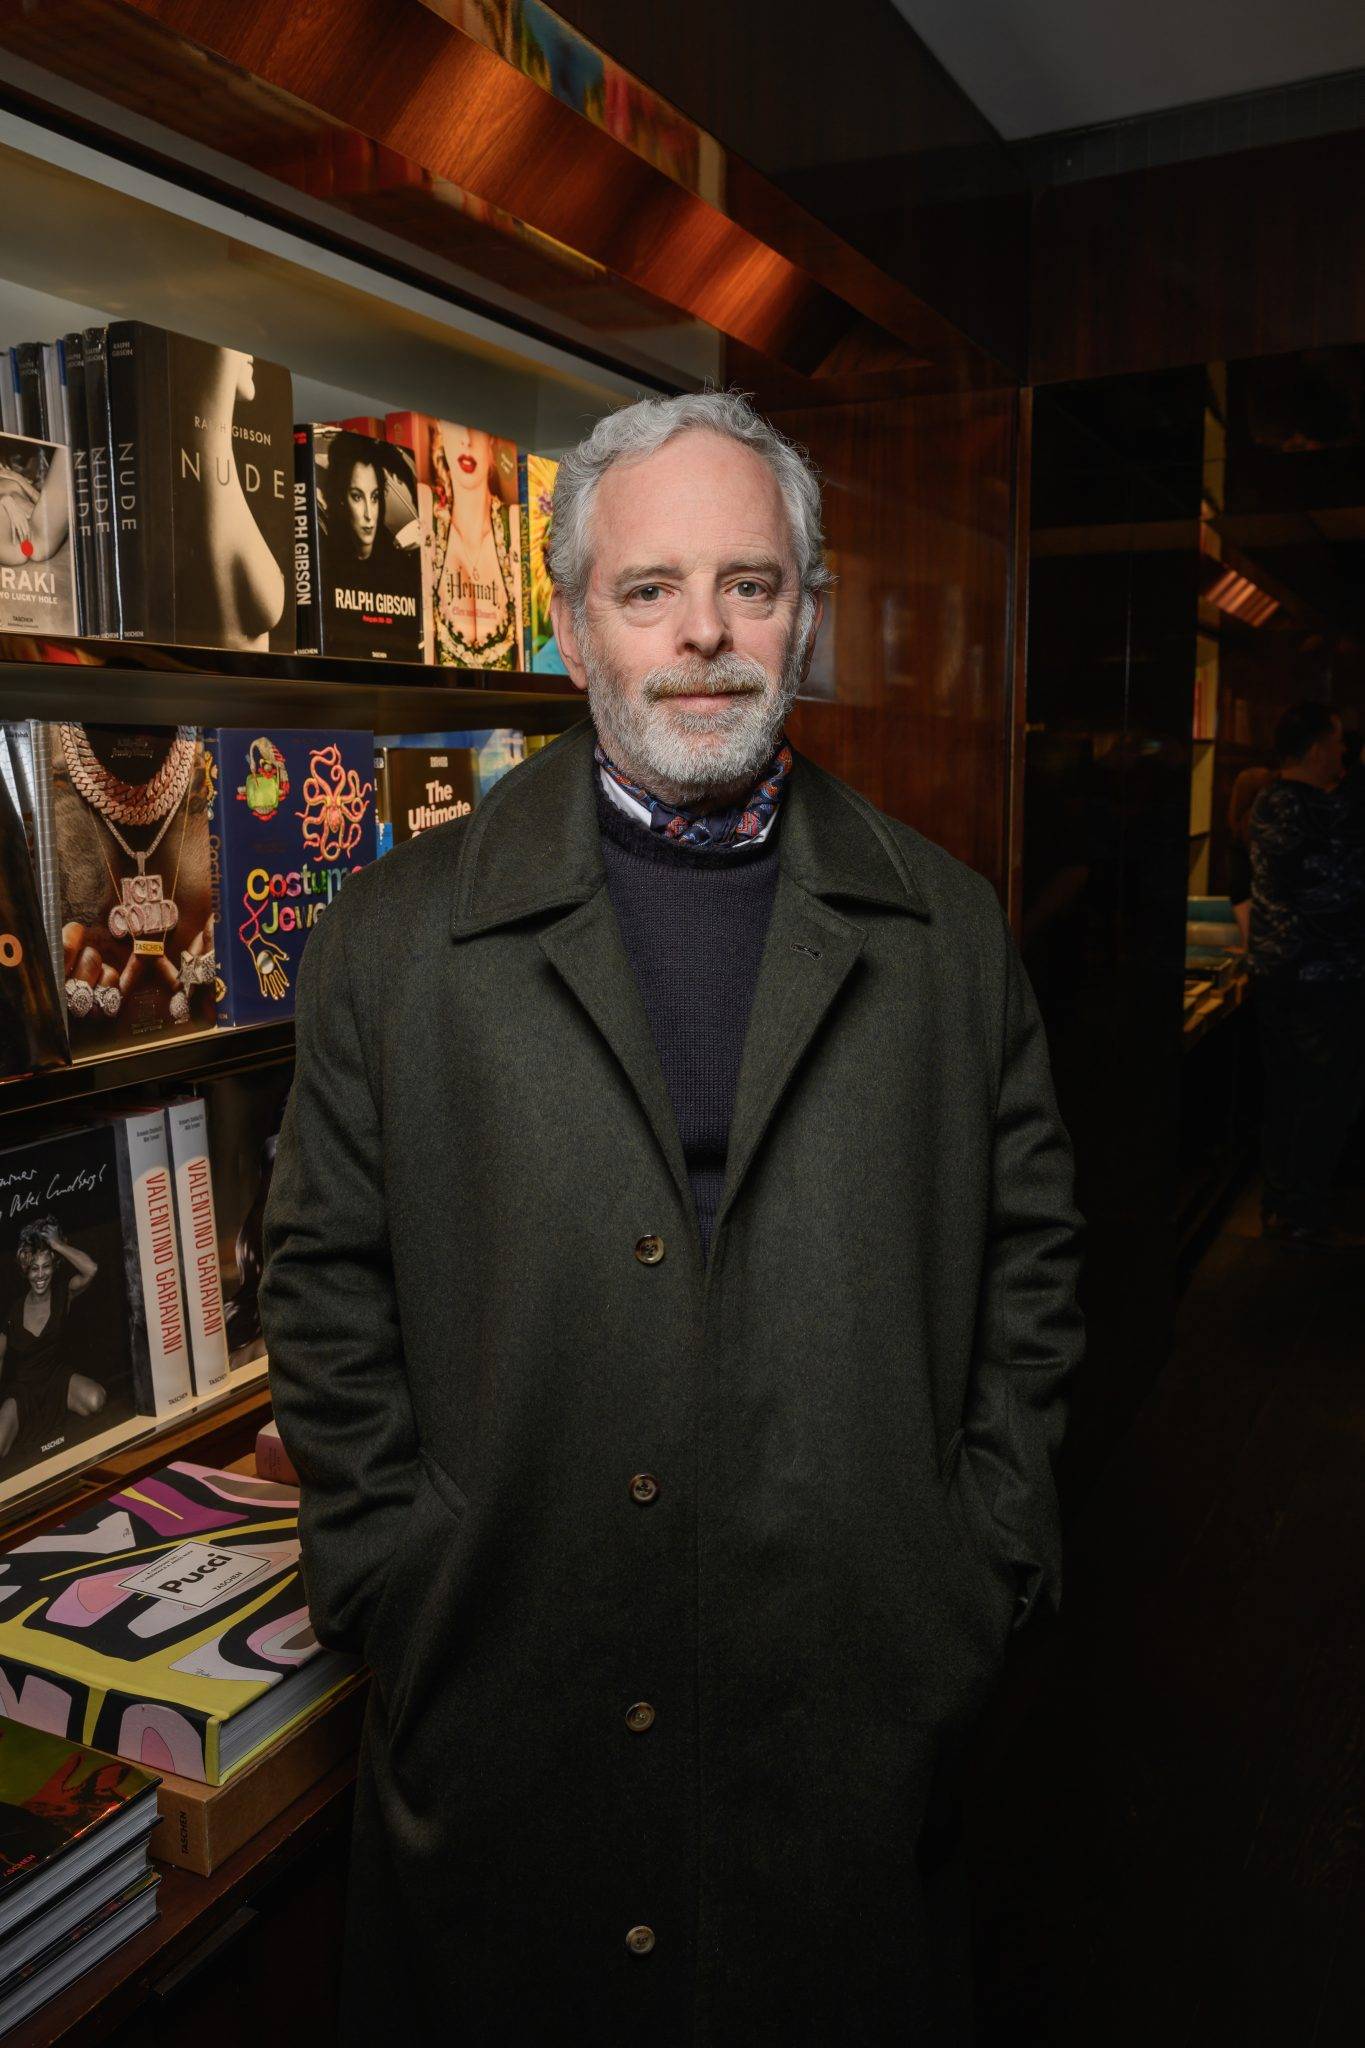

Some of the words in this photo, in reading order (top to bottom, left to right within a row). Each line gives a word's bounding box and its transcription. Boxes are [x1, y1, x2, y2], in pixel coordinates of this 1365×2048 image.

[195, 415, 227, 434] RAH
[231, 425, 271, 446] GIBSON
[91, 446, 110, 533] NUDE
[118, 443, 137, 530] NUDE
[181, 448, 285, 499] NUDE
[294, 482, 308, 539] RALPH
[295, 542, 312, 605] GIBSON
[11, 592, 36, 602] LUCKY
[38, 595, 58, 605] HOLE
[335, 588, 374, 612] RALPH
[375, 593, 416, 617] GIBSON
[425, 780, 454, 805] The
[408, 801, 472, 832] Ultimate
[122, 875, 164, 906] ICE
[108, 900, 179, 938] COLD
[135, 942, 164, 952] TASCHEN
[146, 1171, 174, 1266] VALENTINO
[188, 1159, 214, 1250] VALENTINO
[155, 1267, 183, 1356] GARAVANI
[197, 1252, 223, 1338] GARAVANI
[41, 1436, 65, 1453] TASCHEN
[157, 1552, 234, 1595] Pucci
[212, 1571, 244, 1592] TASCHEN
[180, 1810, 190, 1856] TASCHEN
